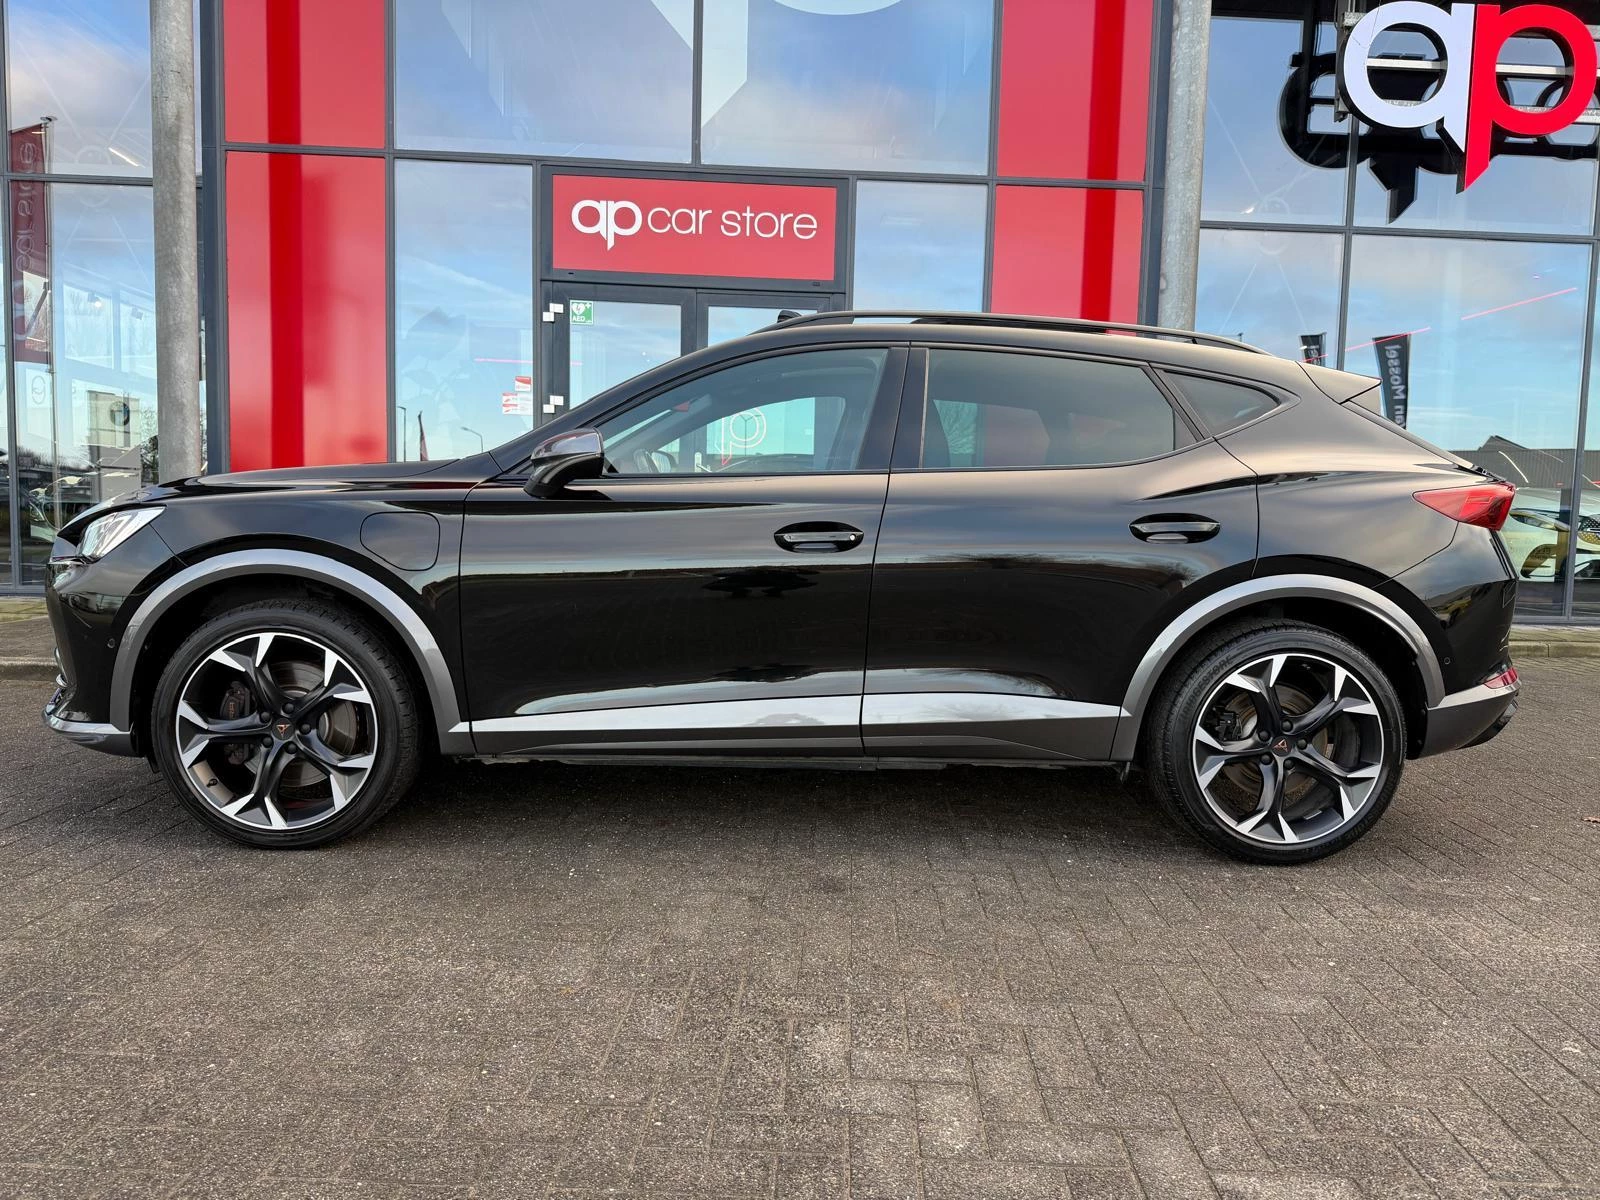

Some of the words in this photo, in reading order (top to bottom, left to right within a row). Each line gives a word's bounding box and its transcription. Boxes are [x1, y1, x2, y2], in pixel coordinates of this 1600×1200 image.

[1343, 1, 1597, 190] ap
[571, 199, 643, 251] ap
[647, 208, 712, 235] car
[720, 206, 818, 240] store
